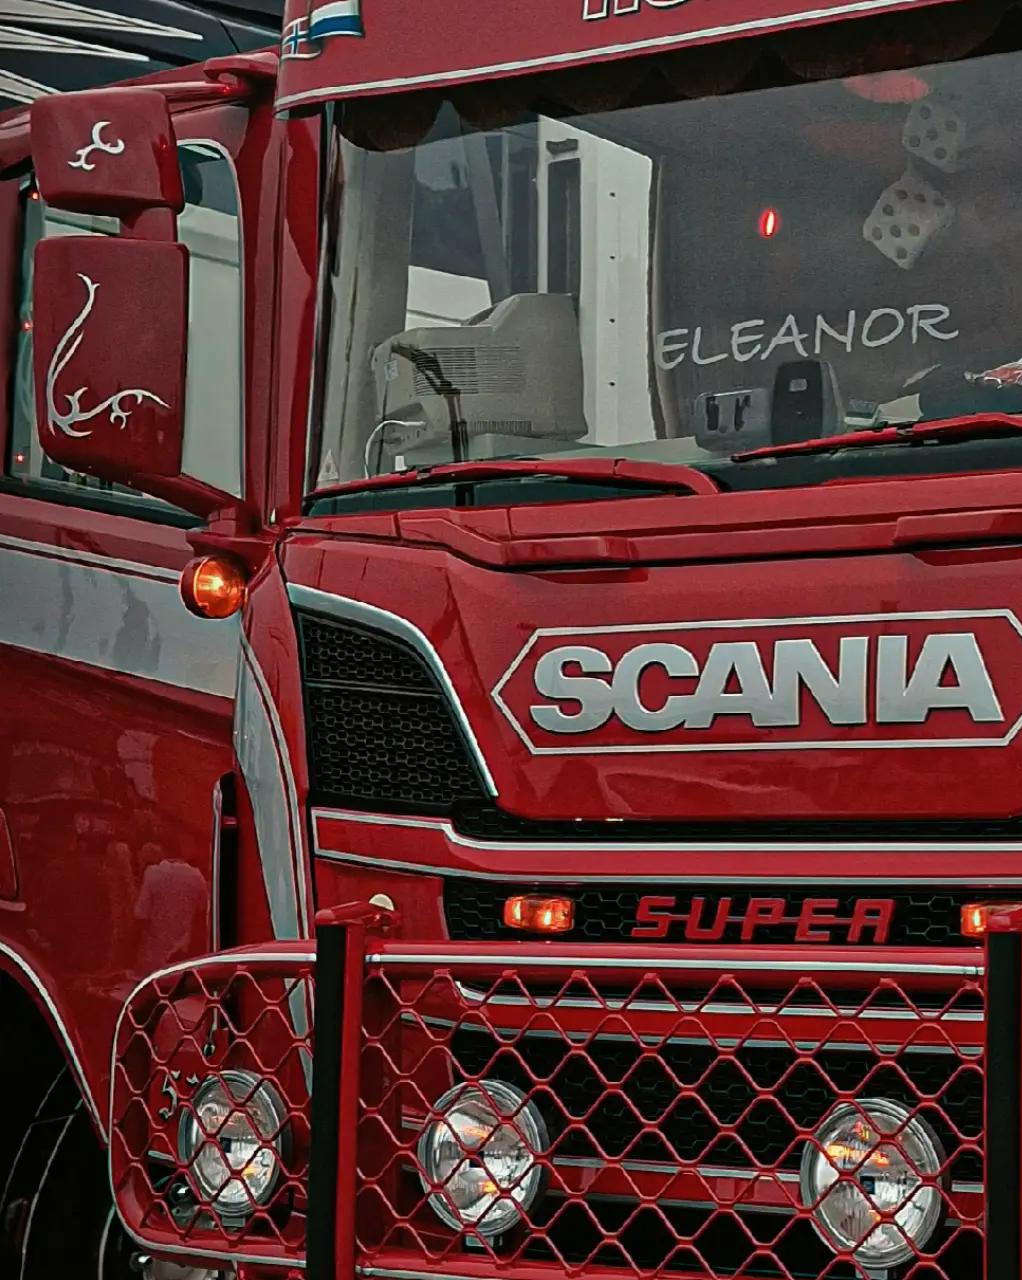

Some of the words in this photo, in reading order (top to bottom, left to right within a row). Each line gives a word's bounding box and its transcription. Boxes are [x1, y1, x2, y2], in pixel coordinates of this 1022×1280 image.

[655, 303, 960, 371] ELEANOR
[529, 632, 1005, 733] SCANIA
[630, 895, 896, 944] SUPER
